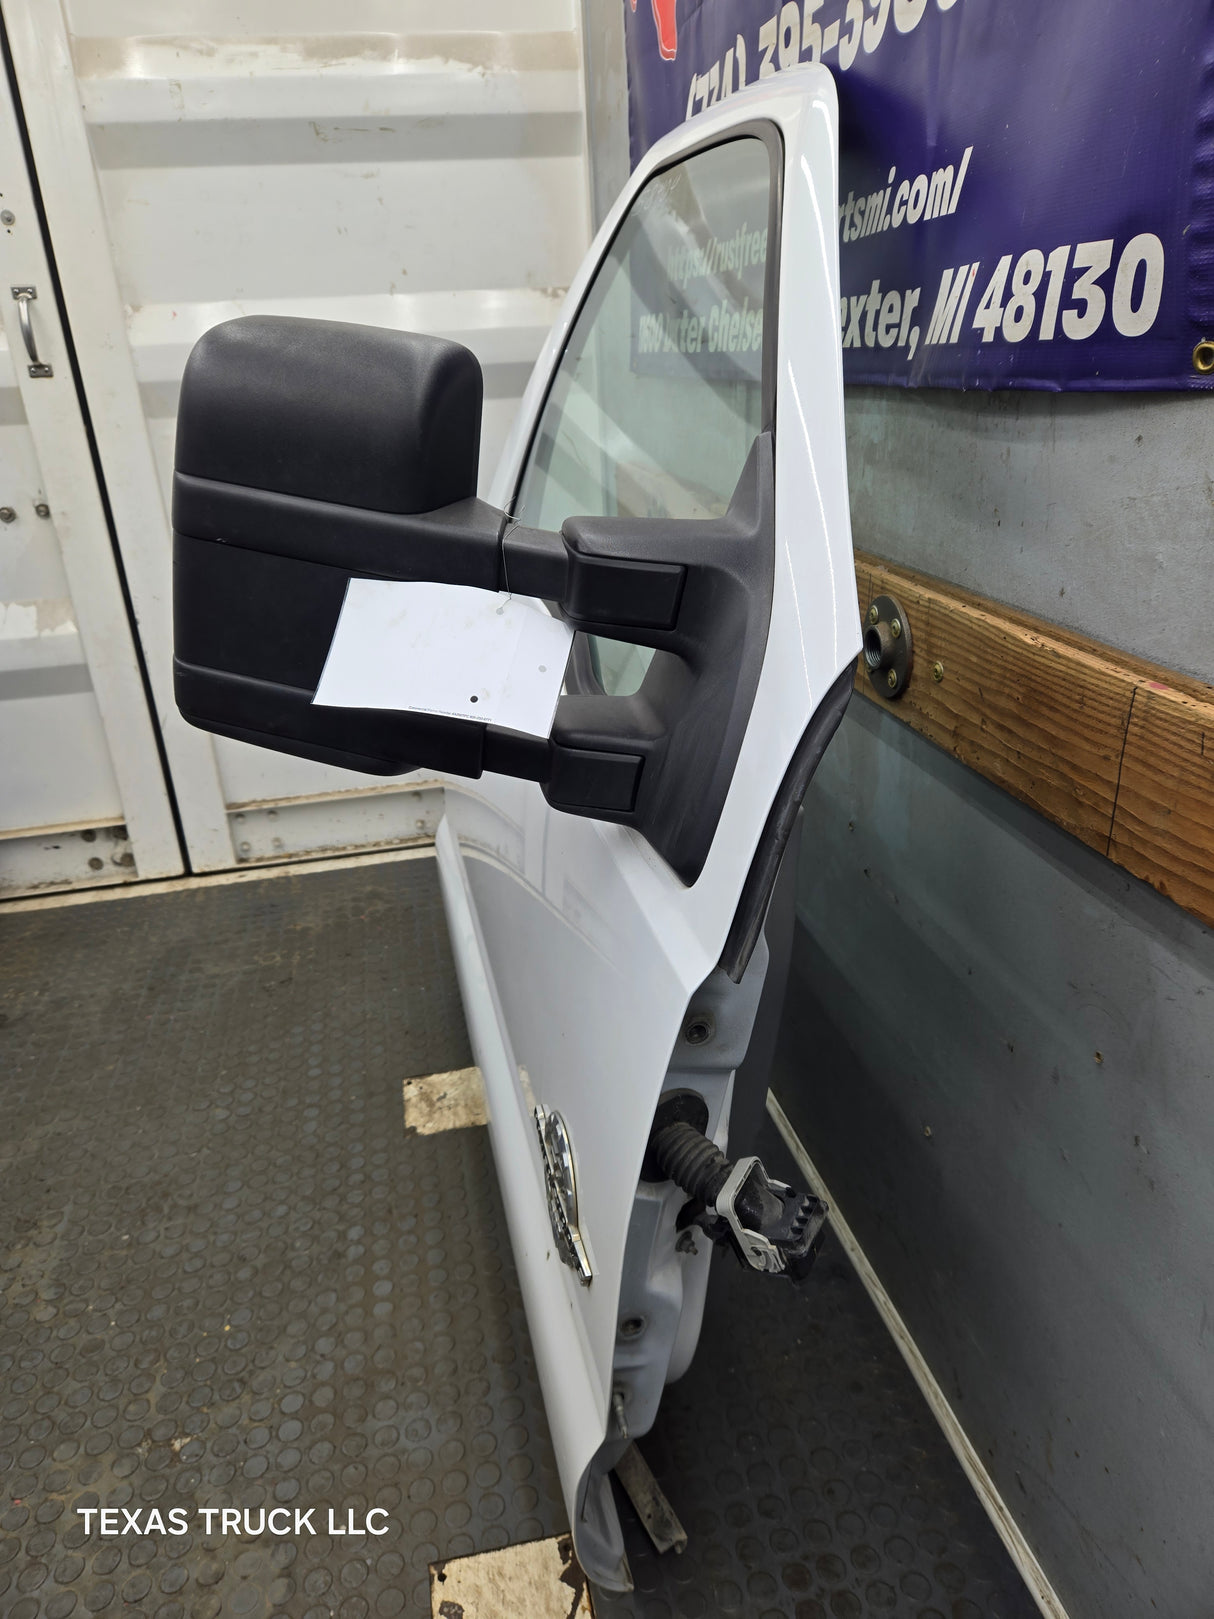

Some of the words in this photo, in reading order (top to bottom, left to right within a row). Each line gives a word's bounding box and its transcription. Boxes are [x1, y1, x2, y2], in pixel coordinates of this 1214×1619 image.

[708, 299, 764, 353] Chelse
[924, 261, 981, 345] MI
[972, 232, 1166, 344] 48130
